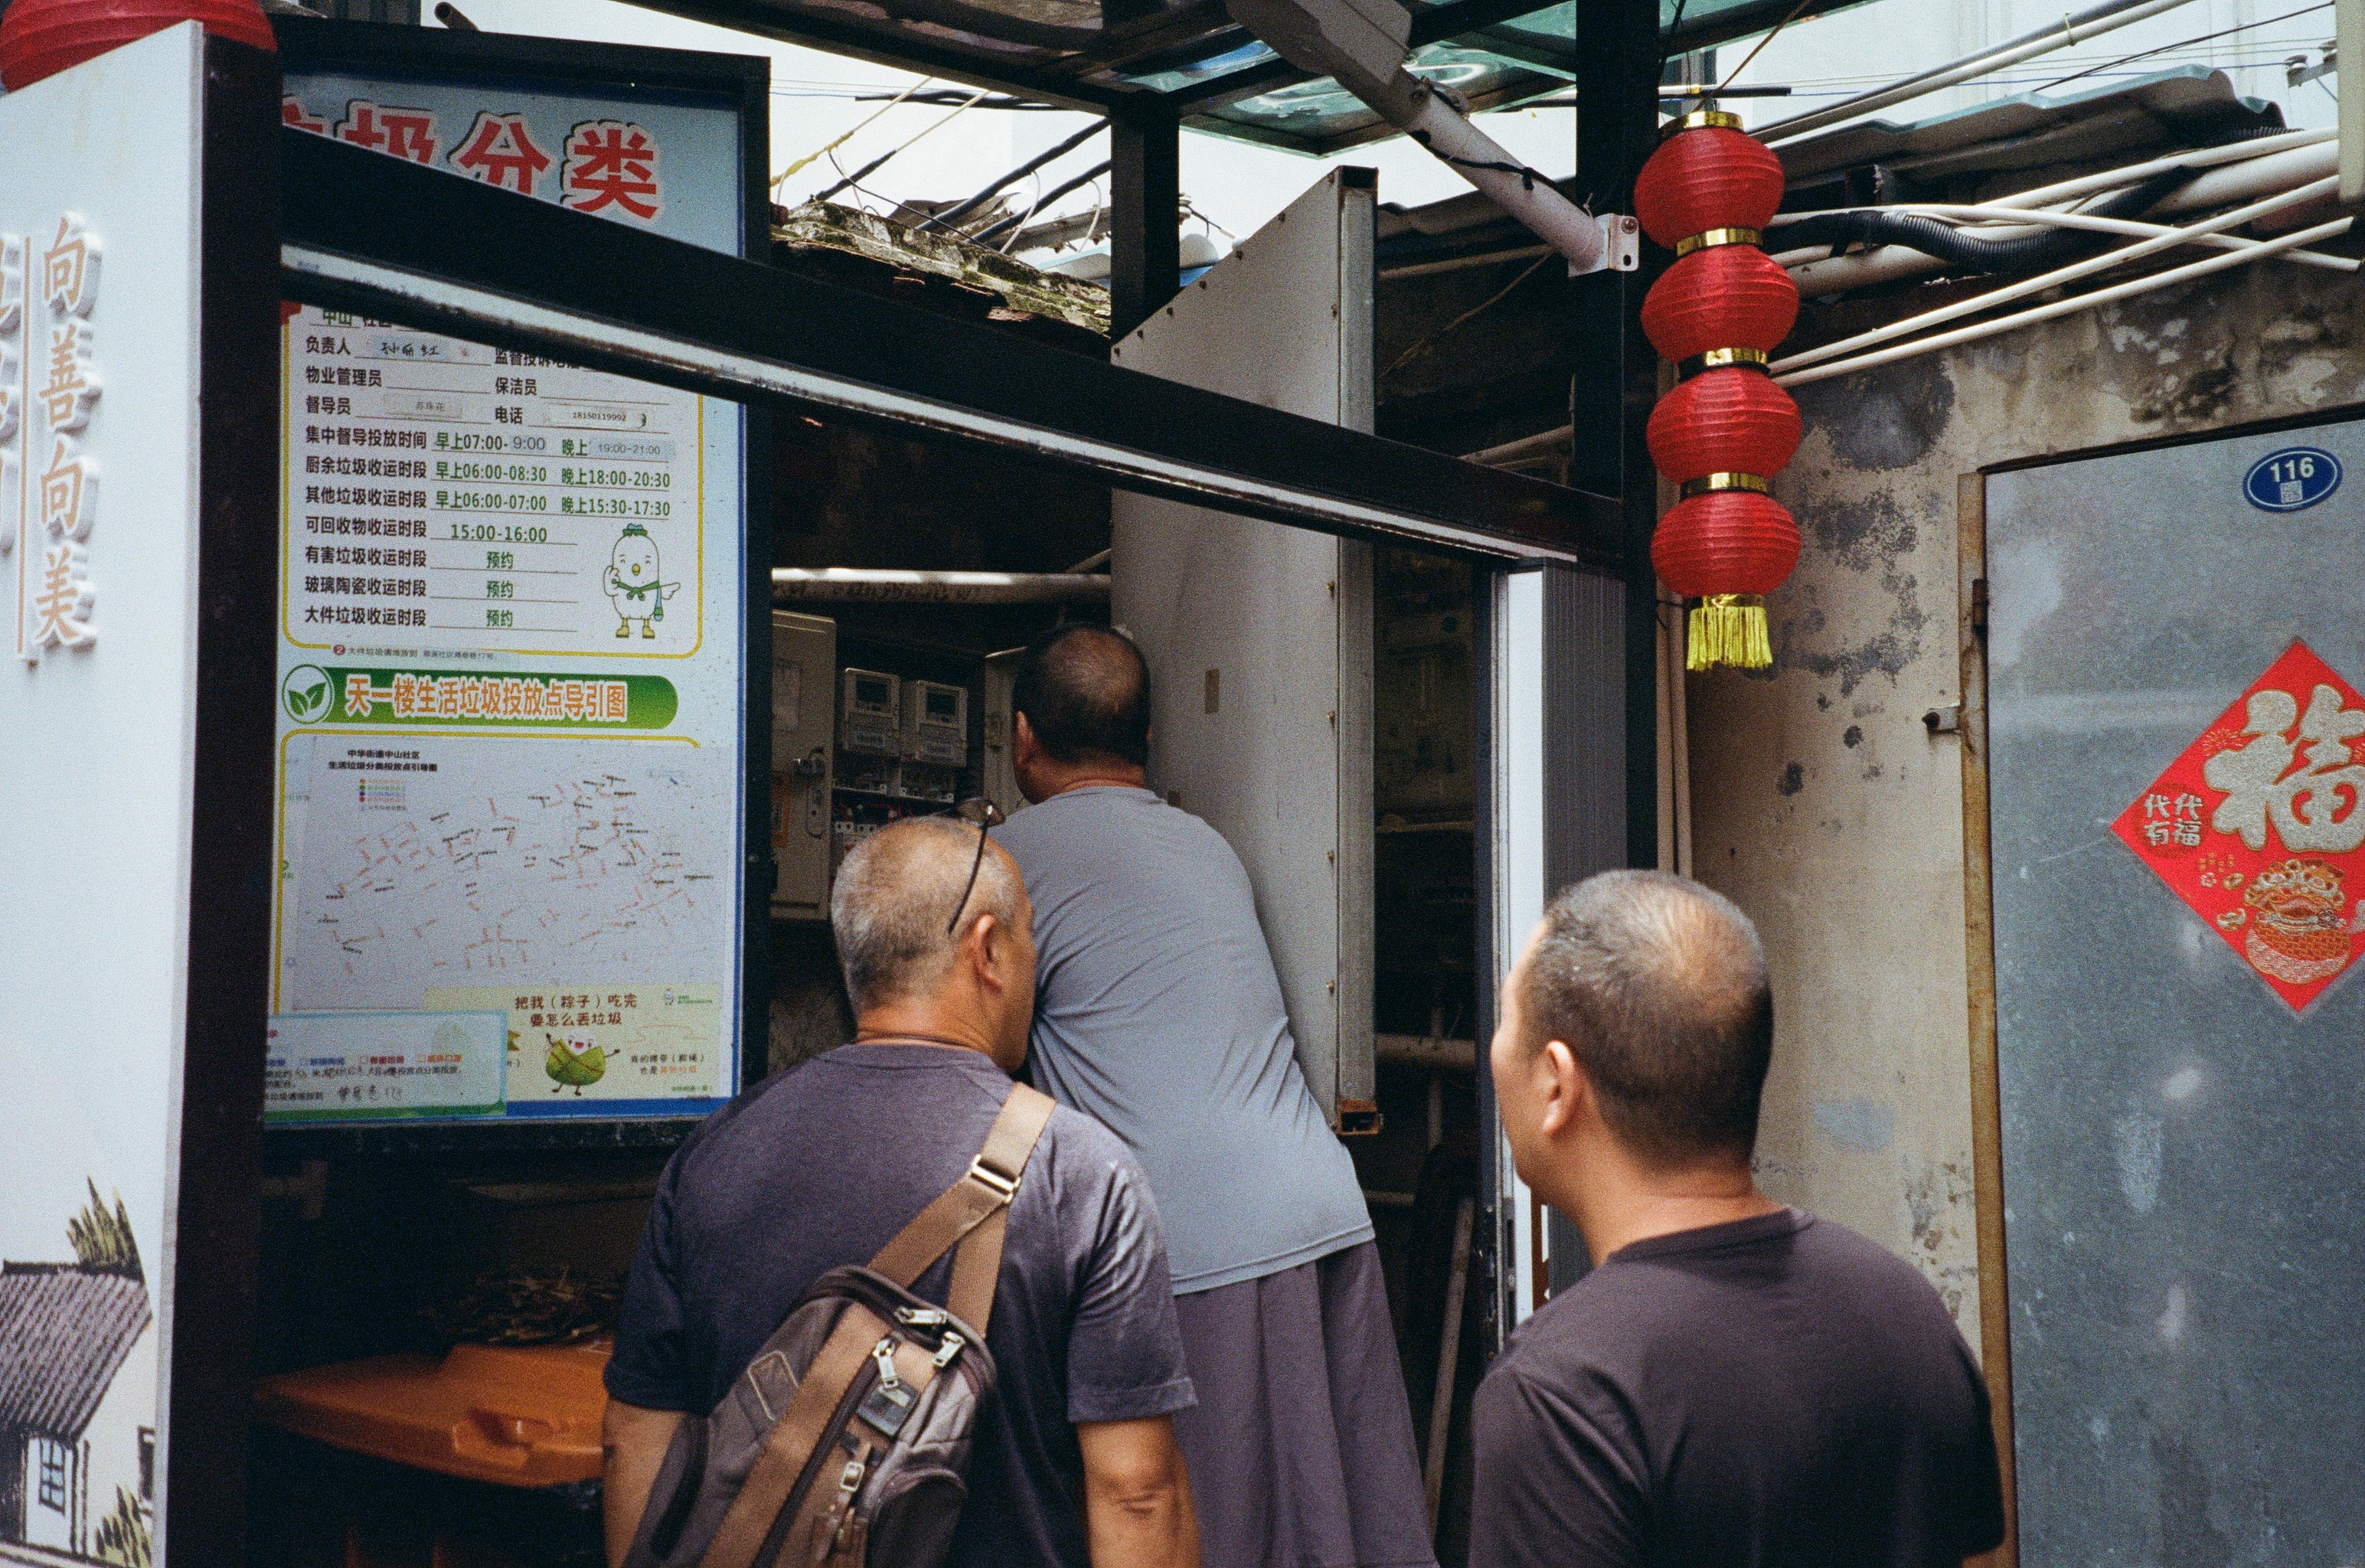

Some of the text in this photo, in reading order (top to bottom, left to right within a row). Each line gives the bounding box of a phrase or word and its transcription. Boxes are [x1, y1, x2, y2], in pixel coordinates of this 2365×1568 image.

[282, 102, 658, 219] 圾分类
[305, 335, 351, 356] 负责人
[305, 366, 383, 388] 物业管理员
[495, 377, 537, 397] 保洁员
[305, 395, 351, 416] 督导员
[495, 405, 524, 425] 电话
[34, 214, 92, 645] 向善向美
[305, 426, 427, 450] 集中督导投放时间
[561, 438, 589, 457] 晚上
[305, 456, 671, 488] 厨余垃圾收运时段 早上06:00-08:30 晚上18:00-20:30
[2270, 456, 2315, 483] 116
[305, 486, 671, 517] 其他垃圾收运时段 早上06:00-07:00 晚上15:30-17:30
[305, 516, 548, 543] 可回收物收运时段 15:00-16:00
[305, 546, 514, 570] 有害垃圾收运时段 预约
[305, 574, 514, 599] 玻璃陶瓷收运时段 预约
[305, 606, 514, 628] 大件垃圾收运时段 预约
[346, 675, 628, 720] 天一楼生活垃圾投放点导引图
[2203, 683, 2365, 853] 福
[2144, 792, 2203, 822] 代代
[2144, 818, 2203, 848] 有福
